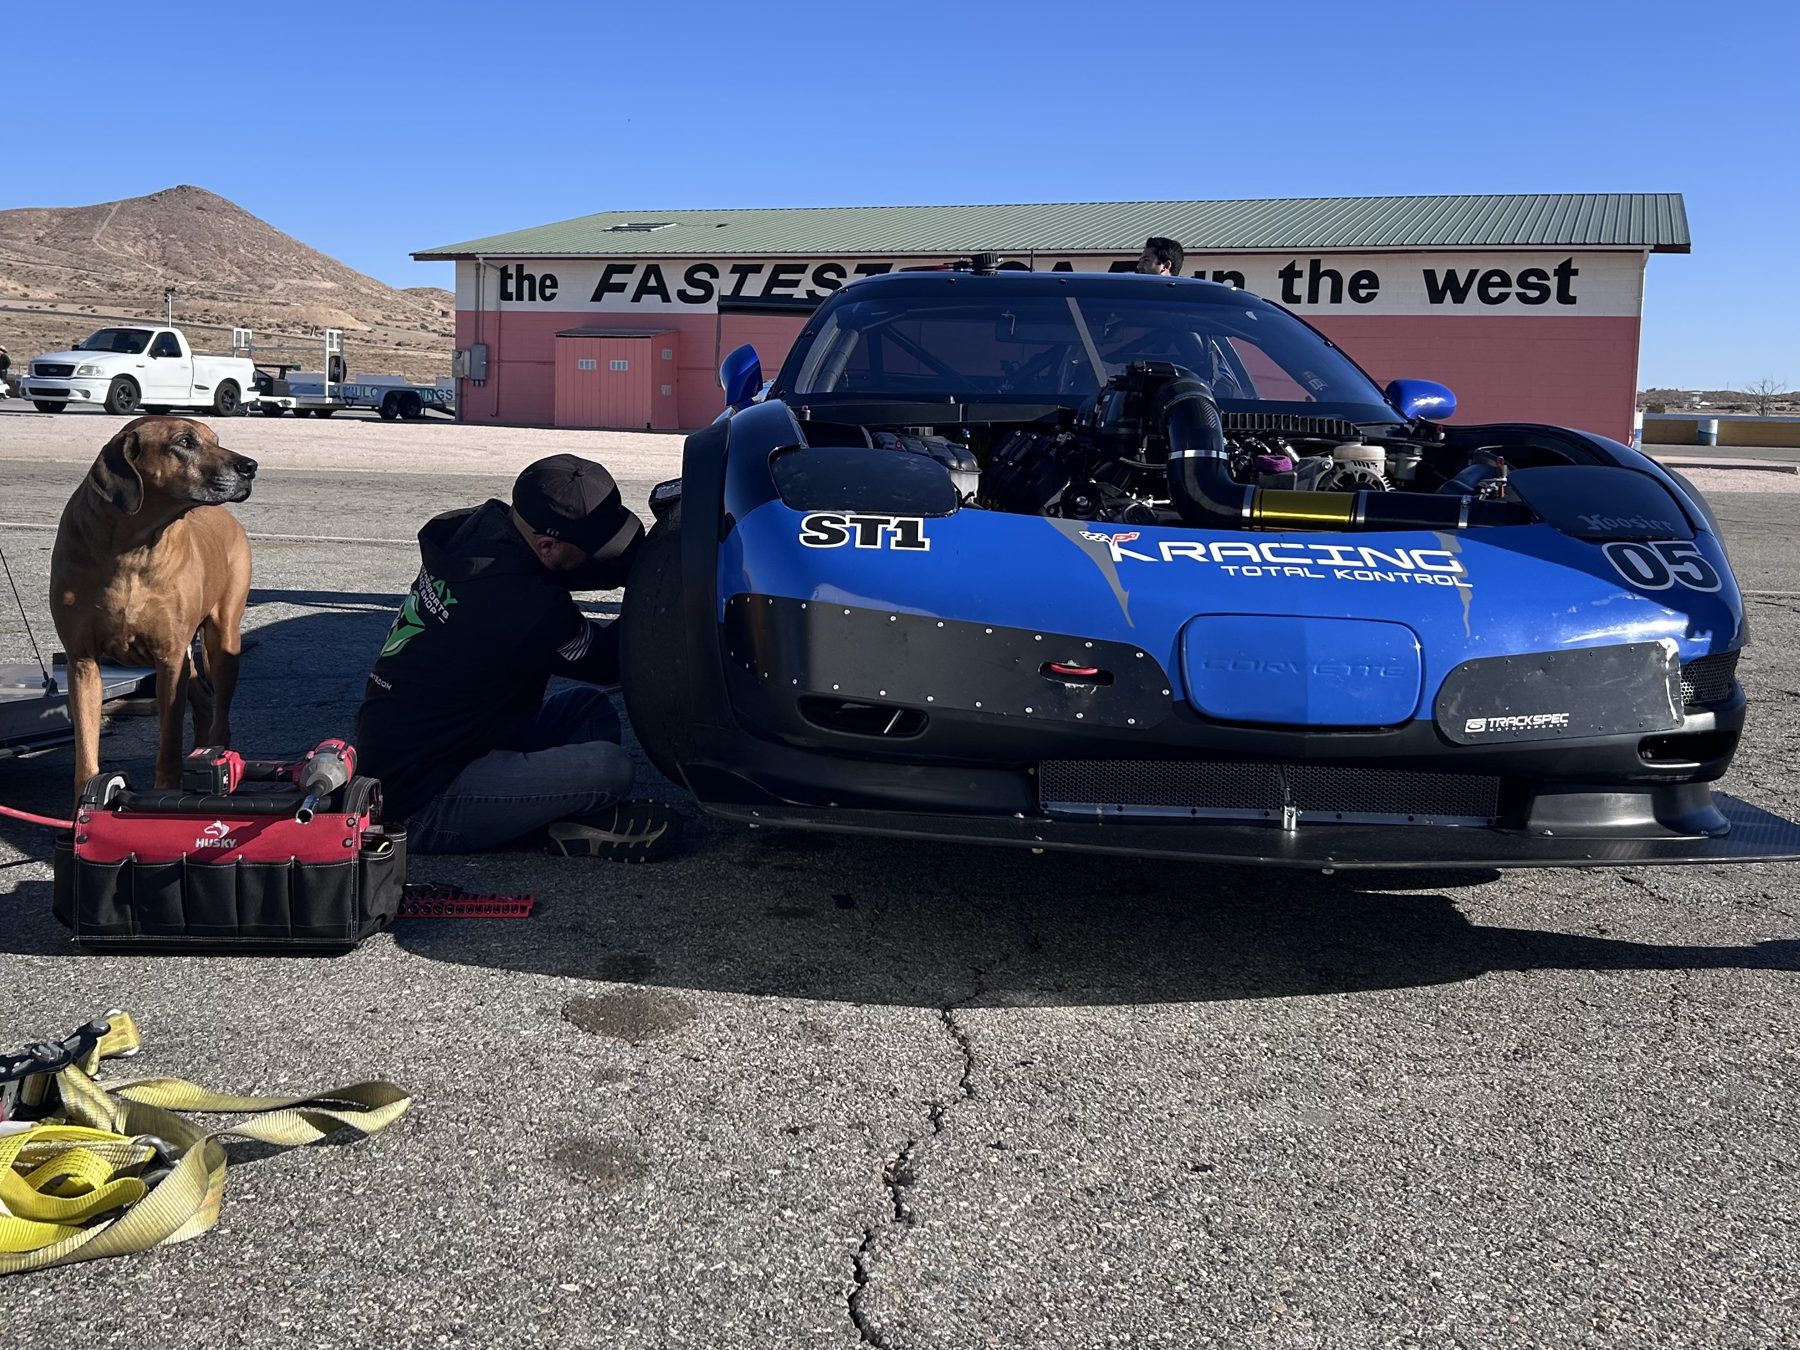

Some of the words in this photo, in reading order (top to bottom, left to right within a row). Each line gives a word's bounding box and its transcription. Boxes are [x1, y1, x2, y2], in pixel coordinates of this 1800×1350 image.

[499, 264, 559, 302] the
[1278, 258, 1380, 304] the
[1422, 257, 1579, 305] west
[799, 513, 931, 551] ST1
[1577, 514, 1675, 532] Hoosier
[1220, 565, 1325, 579] TOTAL
[1334, 568, 1474, 588] KONTROL
[1602, 541, 1722, 593] 05
[1487, 713, 1570, 728] TRACKSPEC
[195, 838, 238, 849] HUSKY
